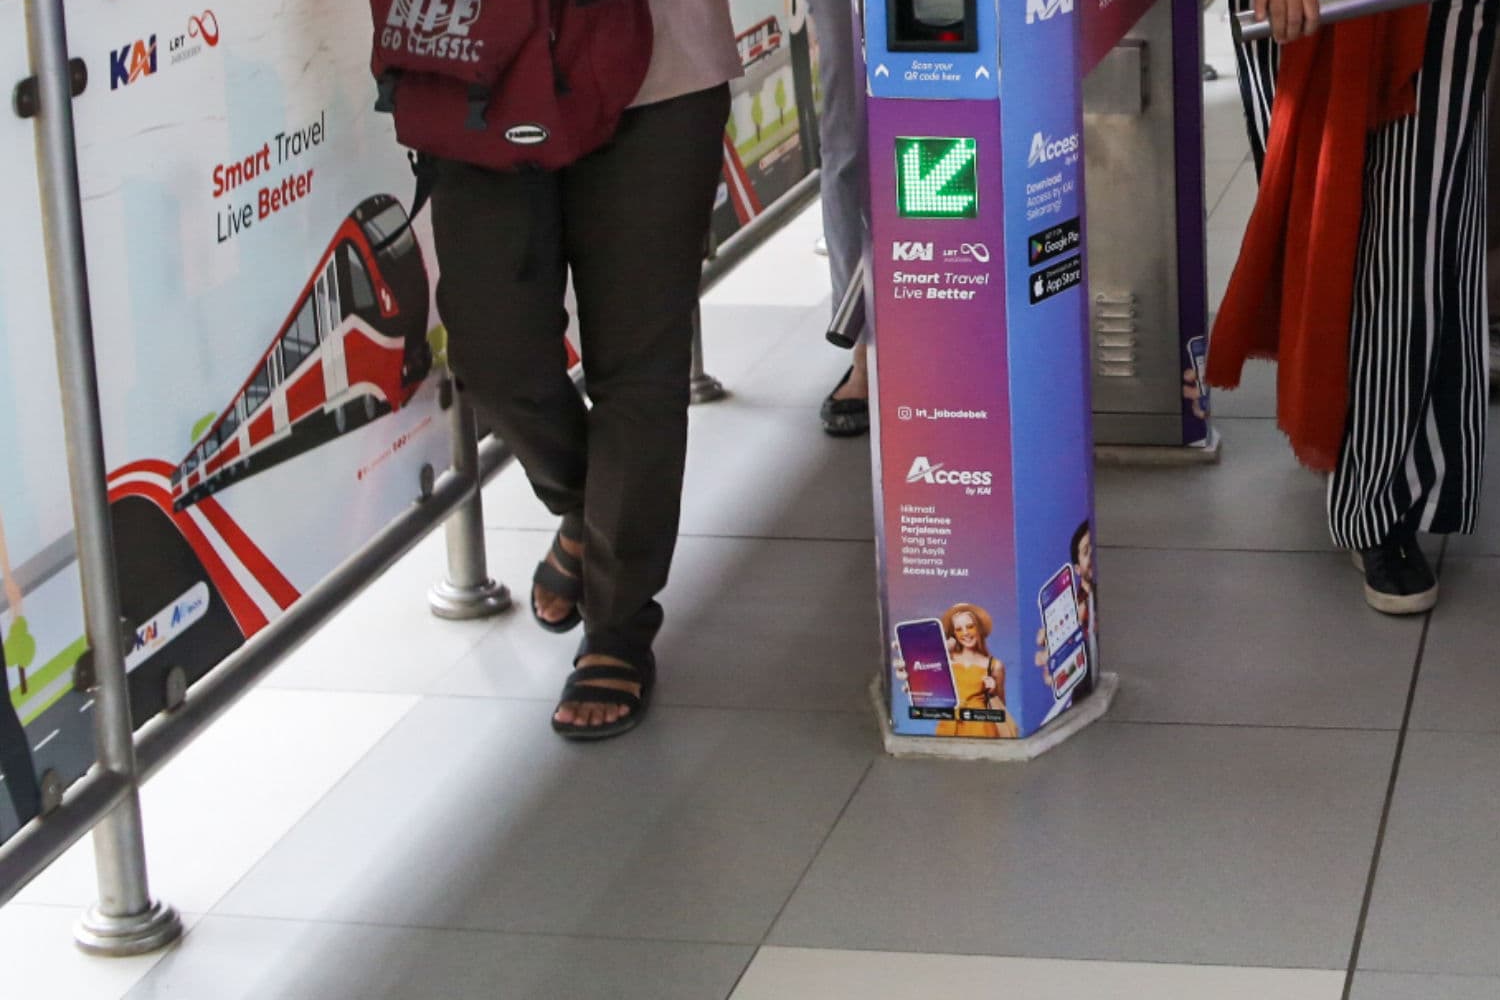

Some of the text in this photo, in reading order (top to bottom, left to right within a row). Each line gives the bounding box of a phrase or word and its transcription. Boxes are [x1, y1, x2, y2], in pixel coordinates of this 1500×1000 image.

[169, 35, 185, 52] LRT
[407, 34, 485, 63] CLASSIC
[109, 33, 157, 92] KAI
[912, 60, 953, 73] Scan your
[904, 71, 961, 82] QR code here
[212, 110, 326, 198] Smart Travel
[216, 168, 315, 244] Live Better
[892, 241, 934, 261] KAI
[893, 271, 990, 285] Smart Travel
[893, 286, 976, 299] Live Better
[905, 455, 992, 485] Access
[977, 487, 992, 496] KAI
